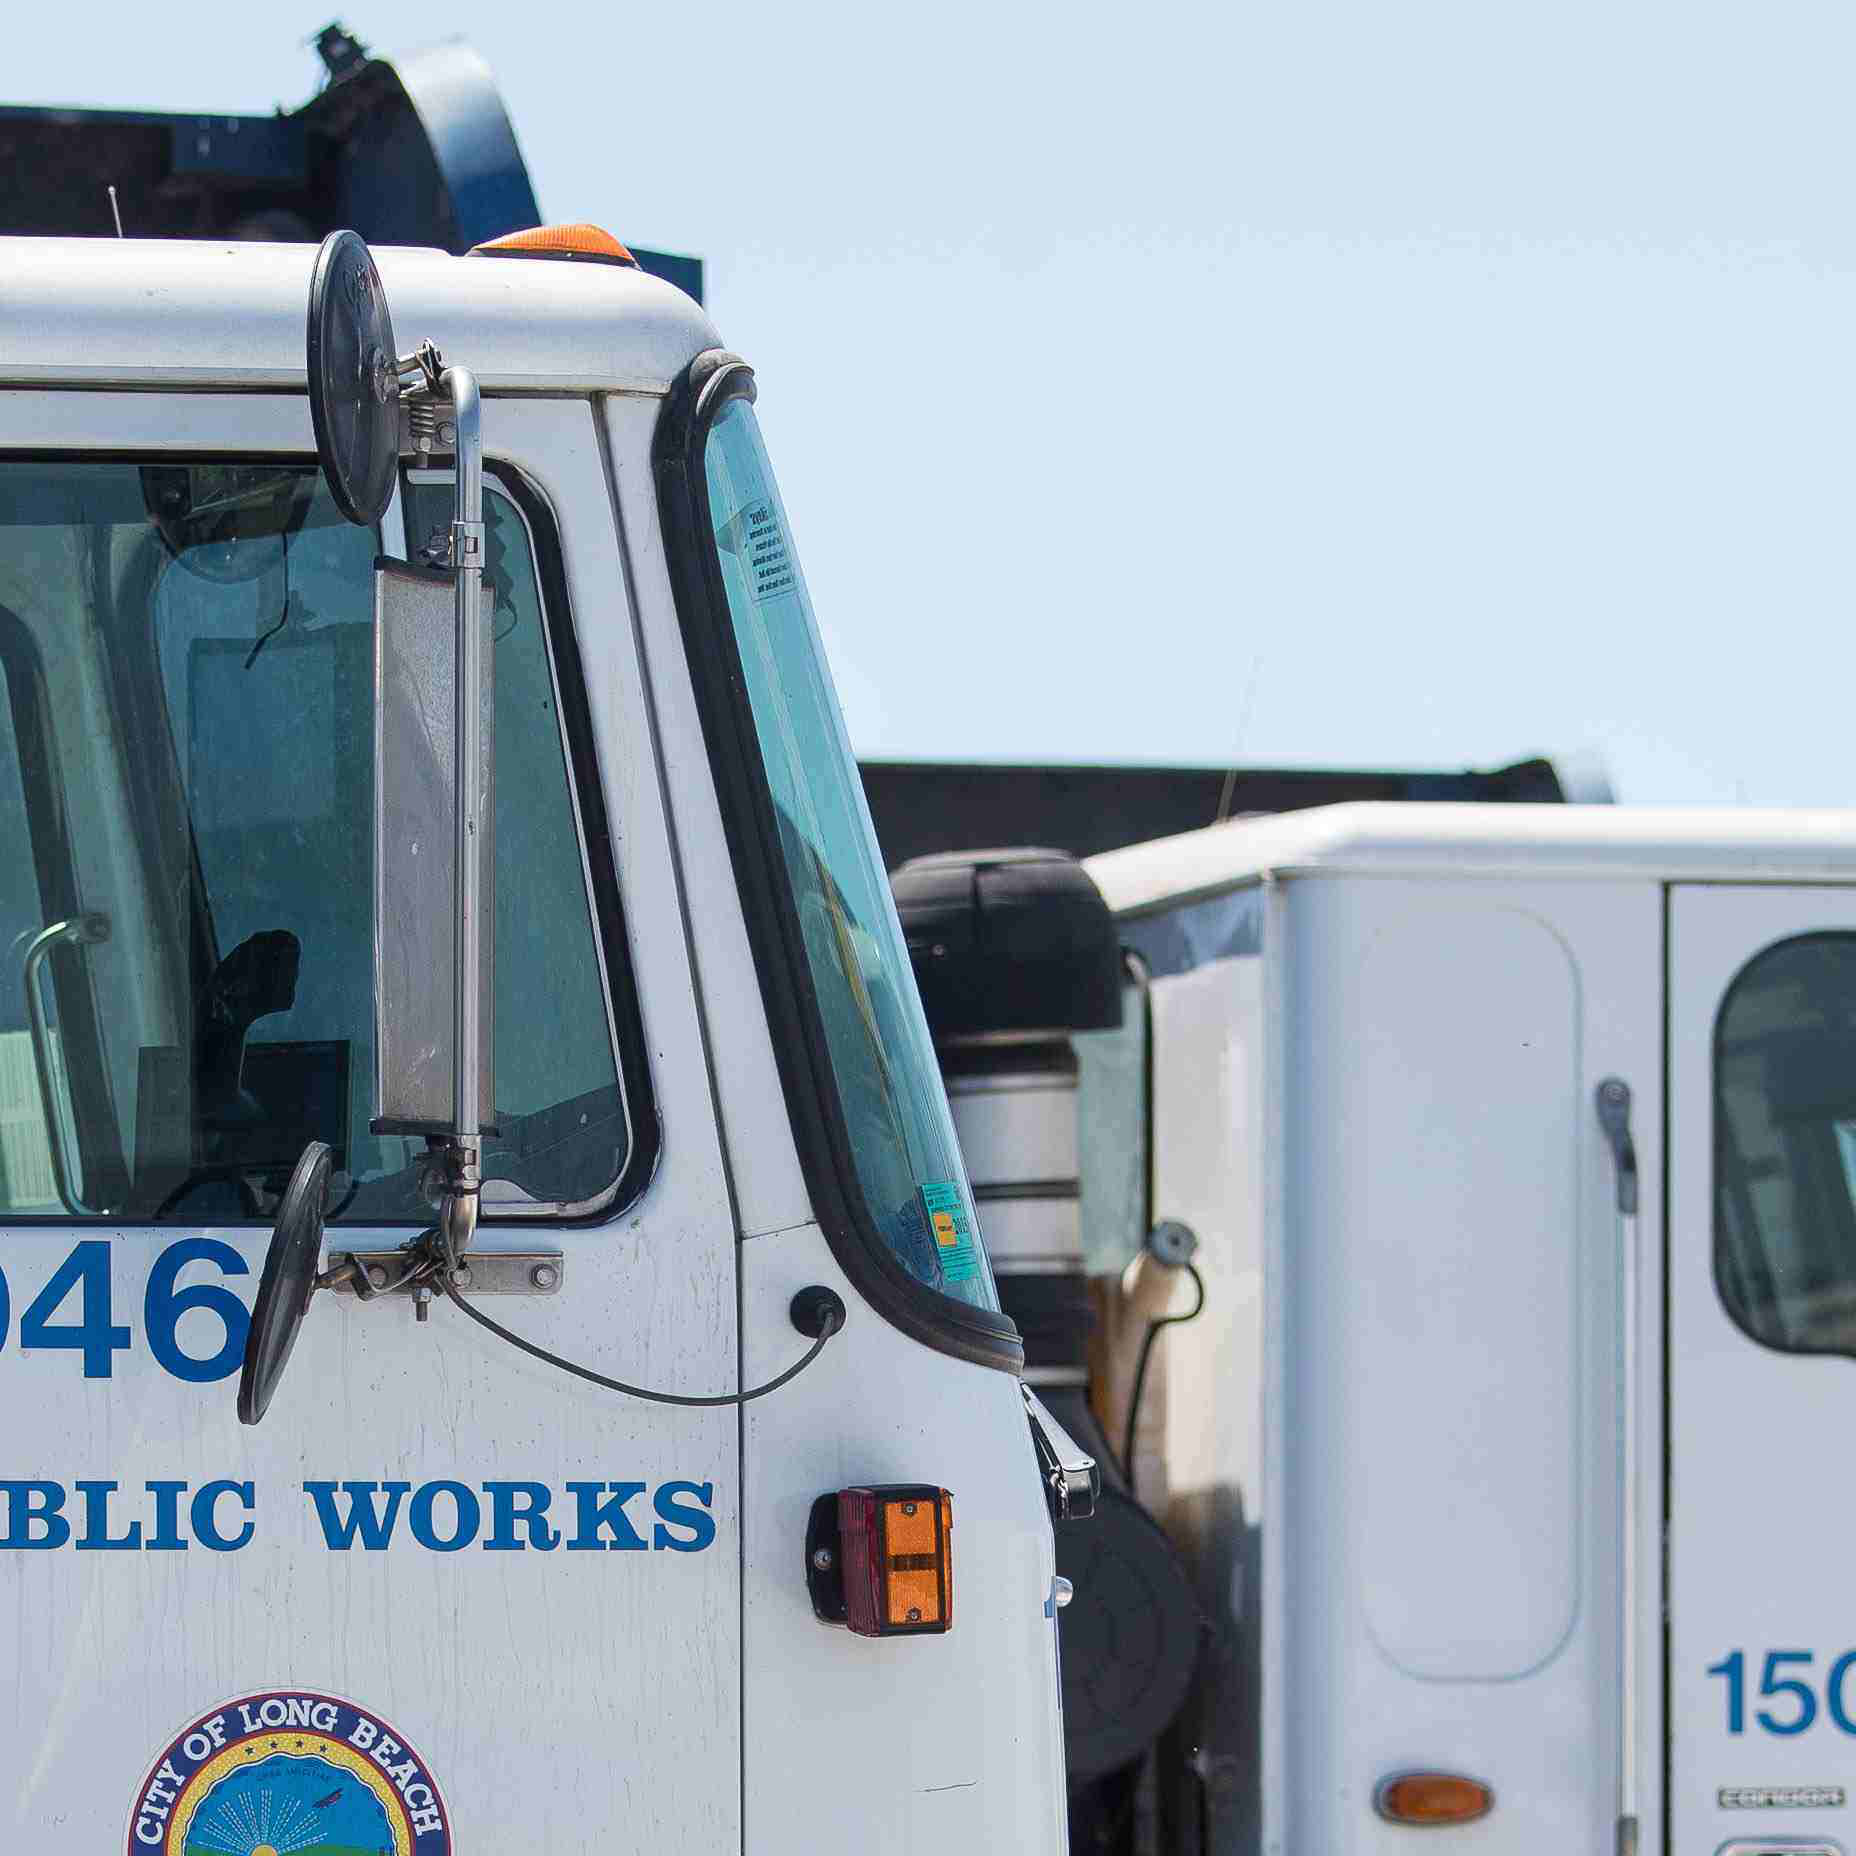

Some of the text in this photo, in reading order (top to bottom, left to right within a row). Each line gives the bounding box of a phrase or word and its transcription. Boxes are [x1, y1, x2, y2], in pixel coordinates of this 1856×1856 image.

[304, 1479, 716, 1553] WORKS
[135, 1698, 443, 1845] CITY OF LONG BEACH
